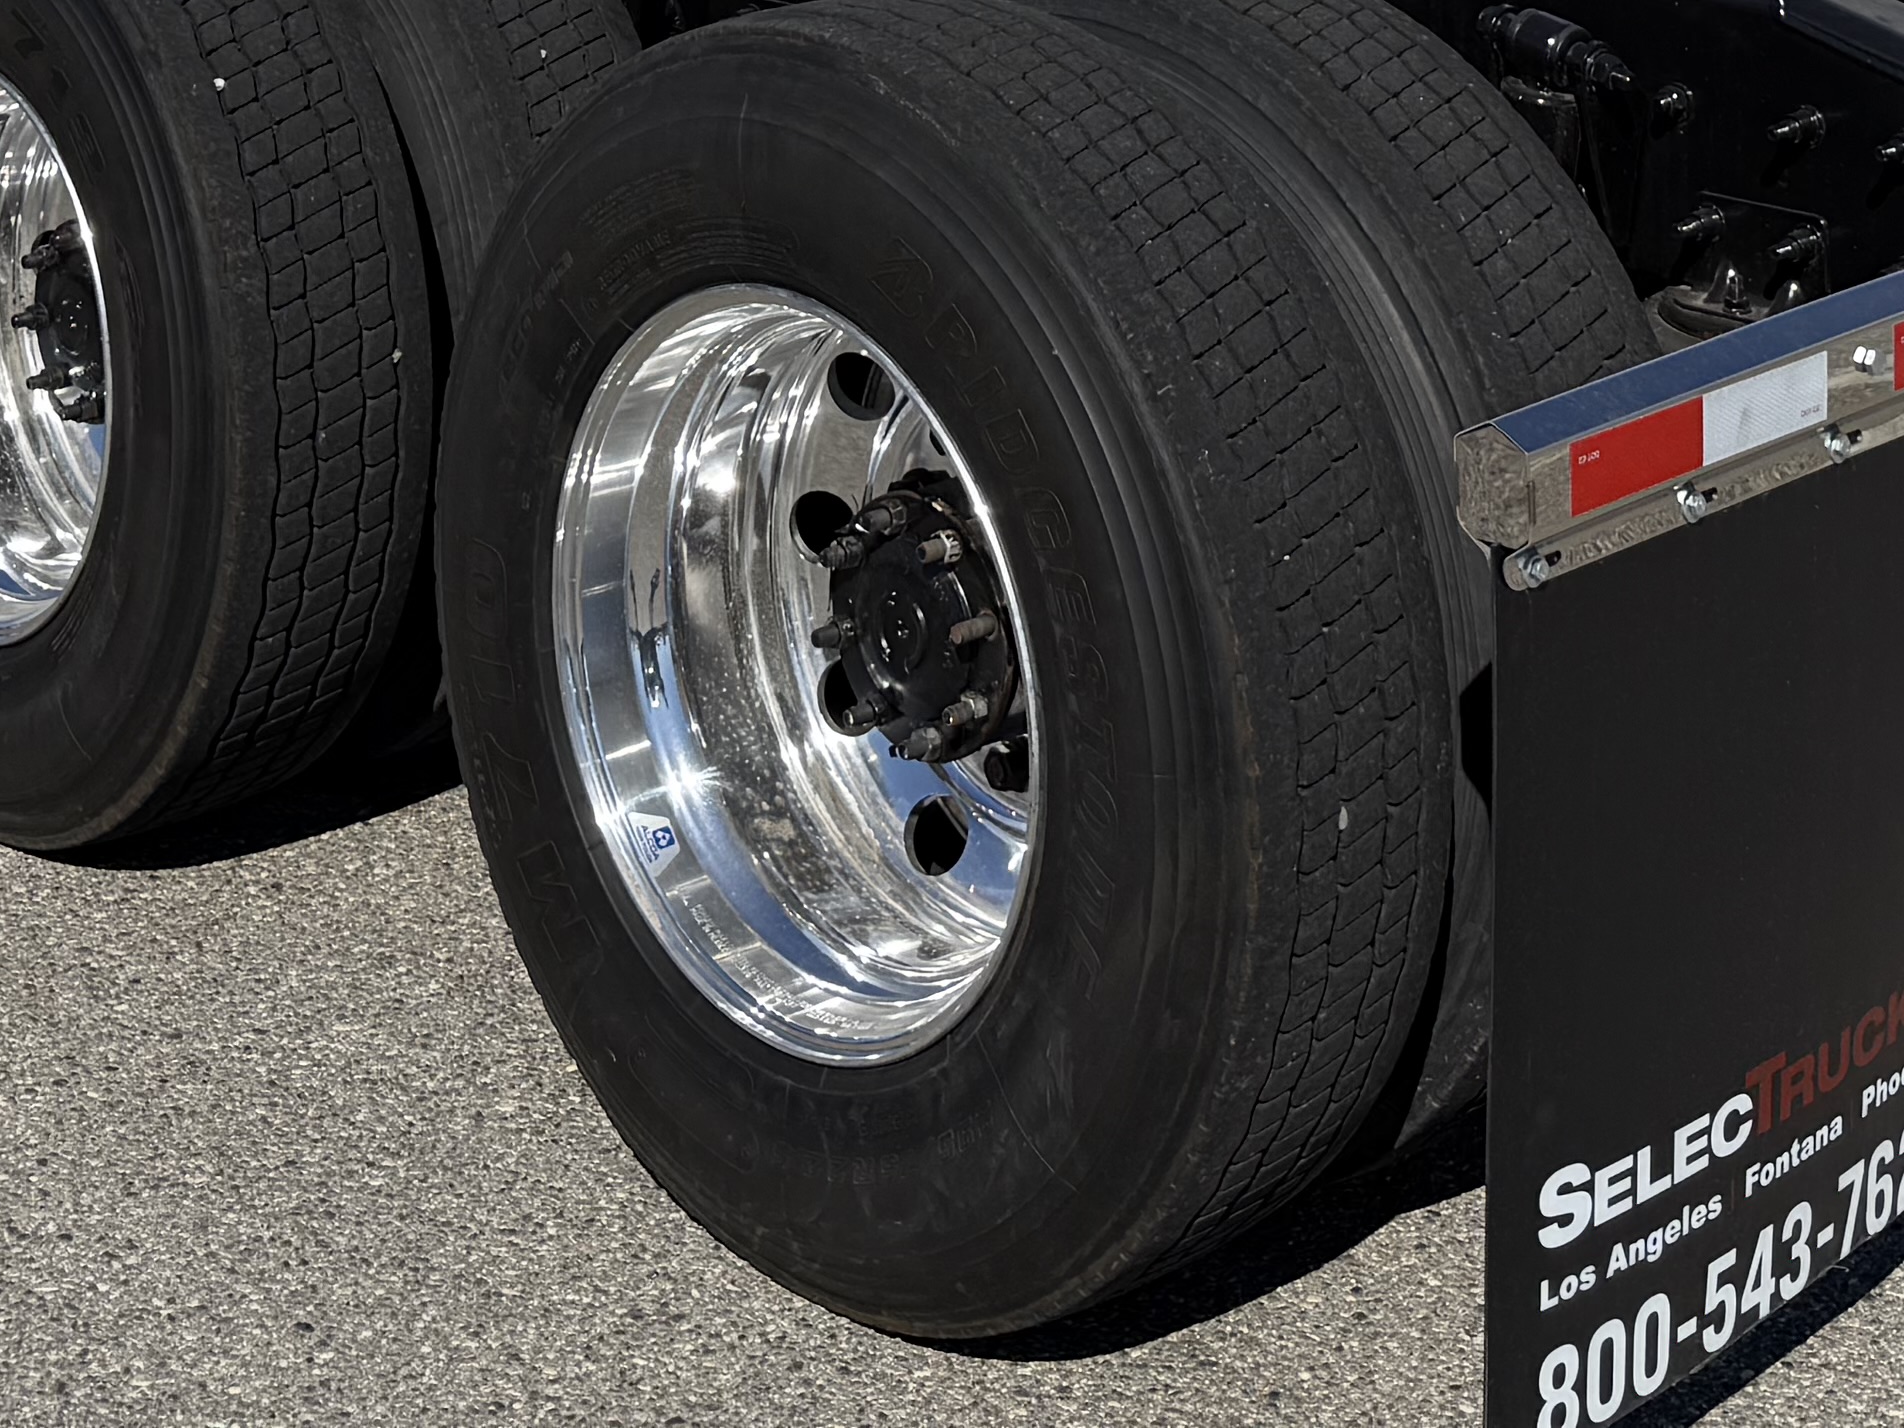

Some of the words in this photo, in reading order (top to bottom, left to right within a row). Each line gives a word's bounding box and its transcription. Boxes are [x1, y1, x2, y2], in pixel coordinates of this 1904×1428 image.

[1540, 1265, 1596, 1312] Los
[1606, 1194, 1723, 1278] Angeles
[1745, 1115, 1843, 1197] Fontana
